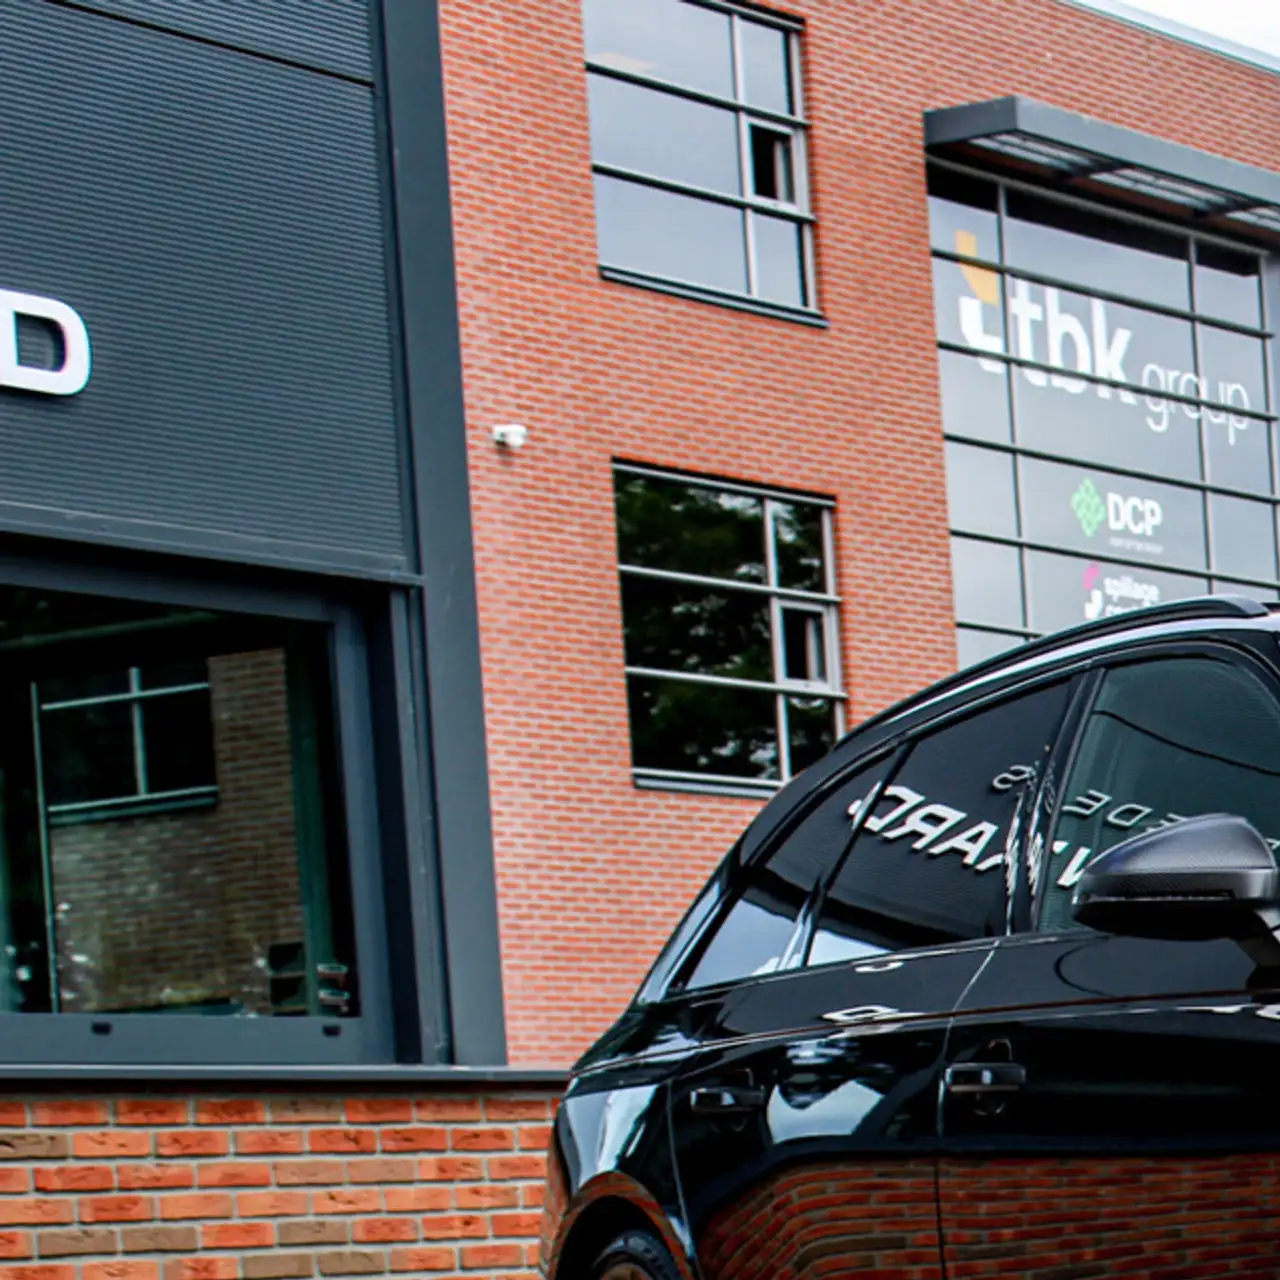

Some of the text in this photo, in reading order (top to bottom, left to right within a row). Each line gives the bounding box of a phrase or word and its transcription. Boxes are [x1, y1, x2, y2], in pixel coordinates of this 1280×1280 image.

[1009, 277, 1250, 446] tbk group
[1106, 491, 1163, 536] DCP
